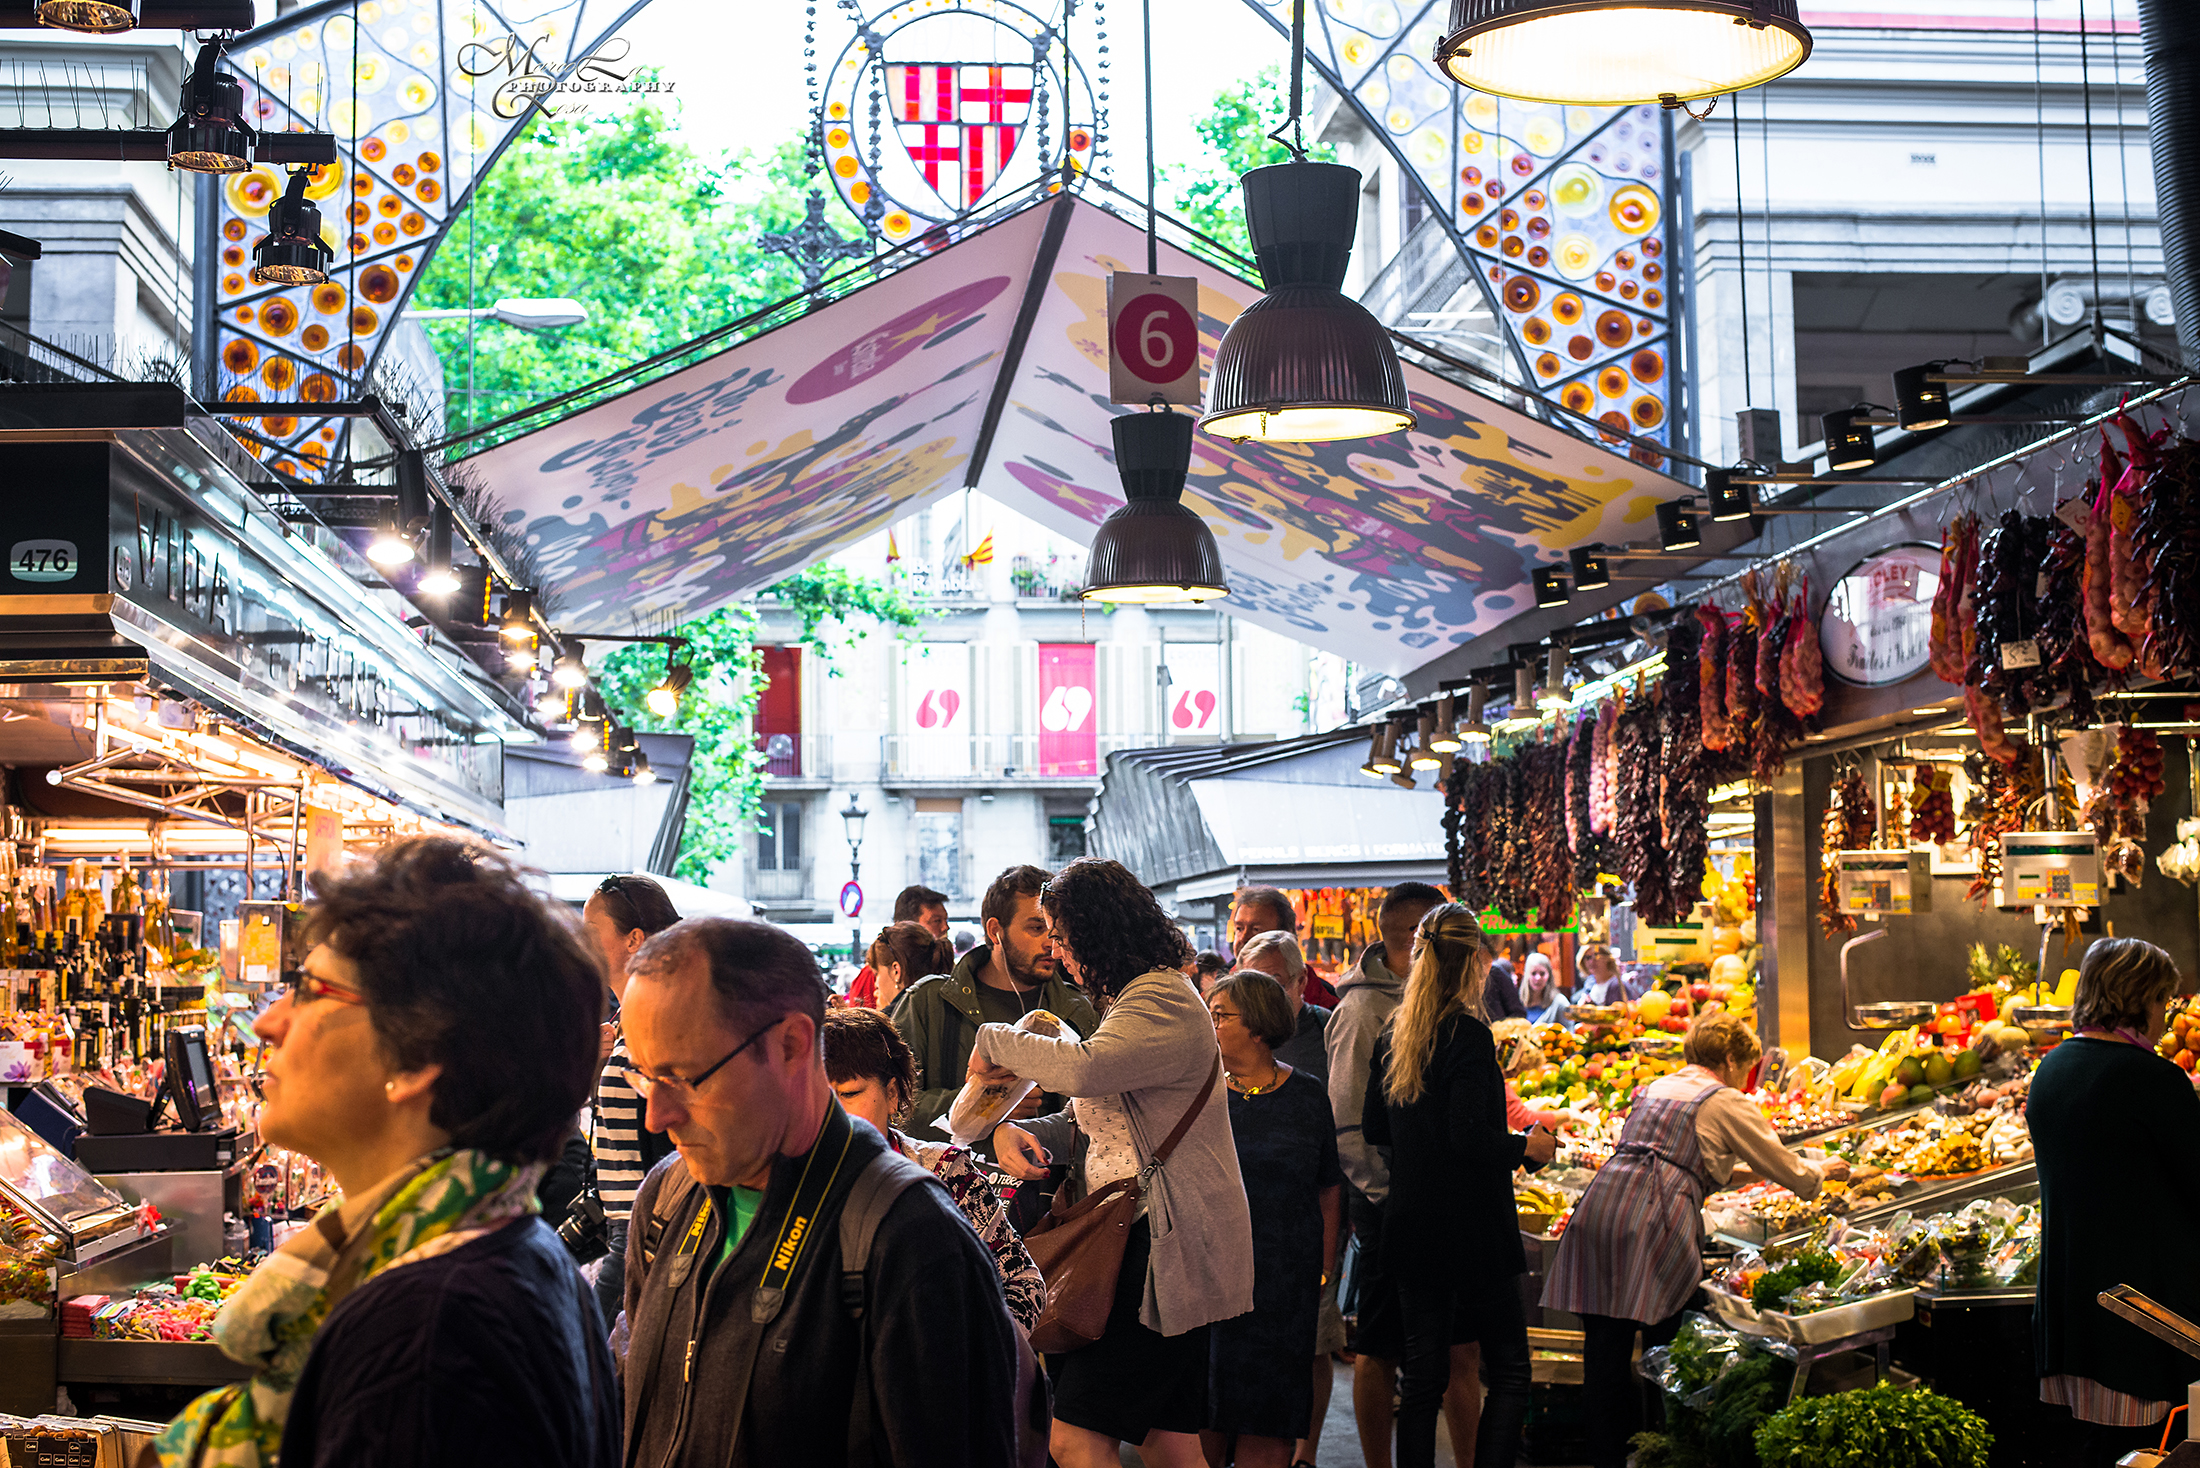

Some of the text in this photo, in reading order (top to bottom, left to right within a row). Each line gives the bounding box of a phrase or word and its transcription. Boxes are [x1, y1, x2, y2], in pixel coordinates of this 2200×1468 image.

[1140, 310, 1174, 368] 6
[19, 549, 69, 573] 476
[774, 1215, 808, 1271] Nikon
